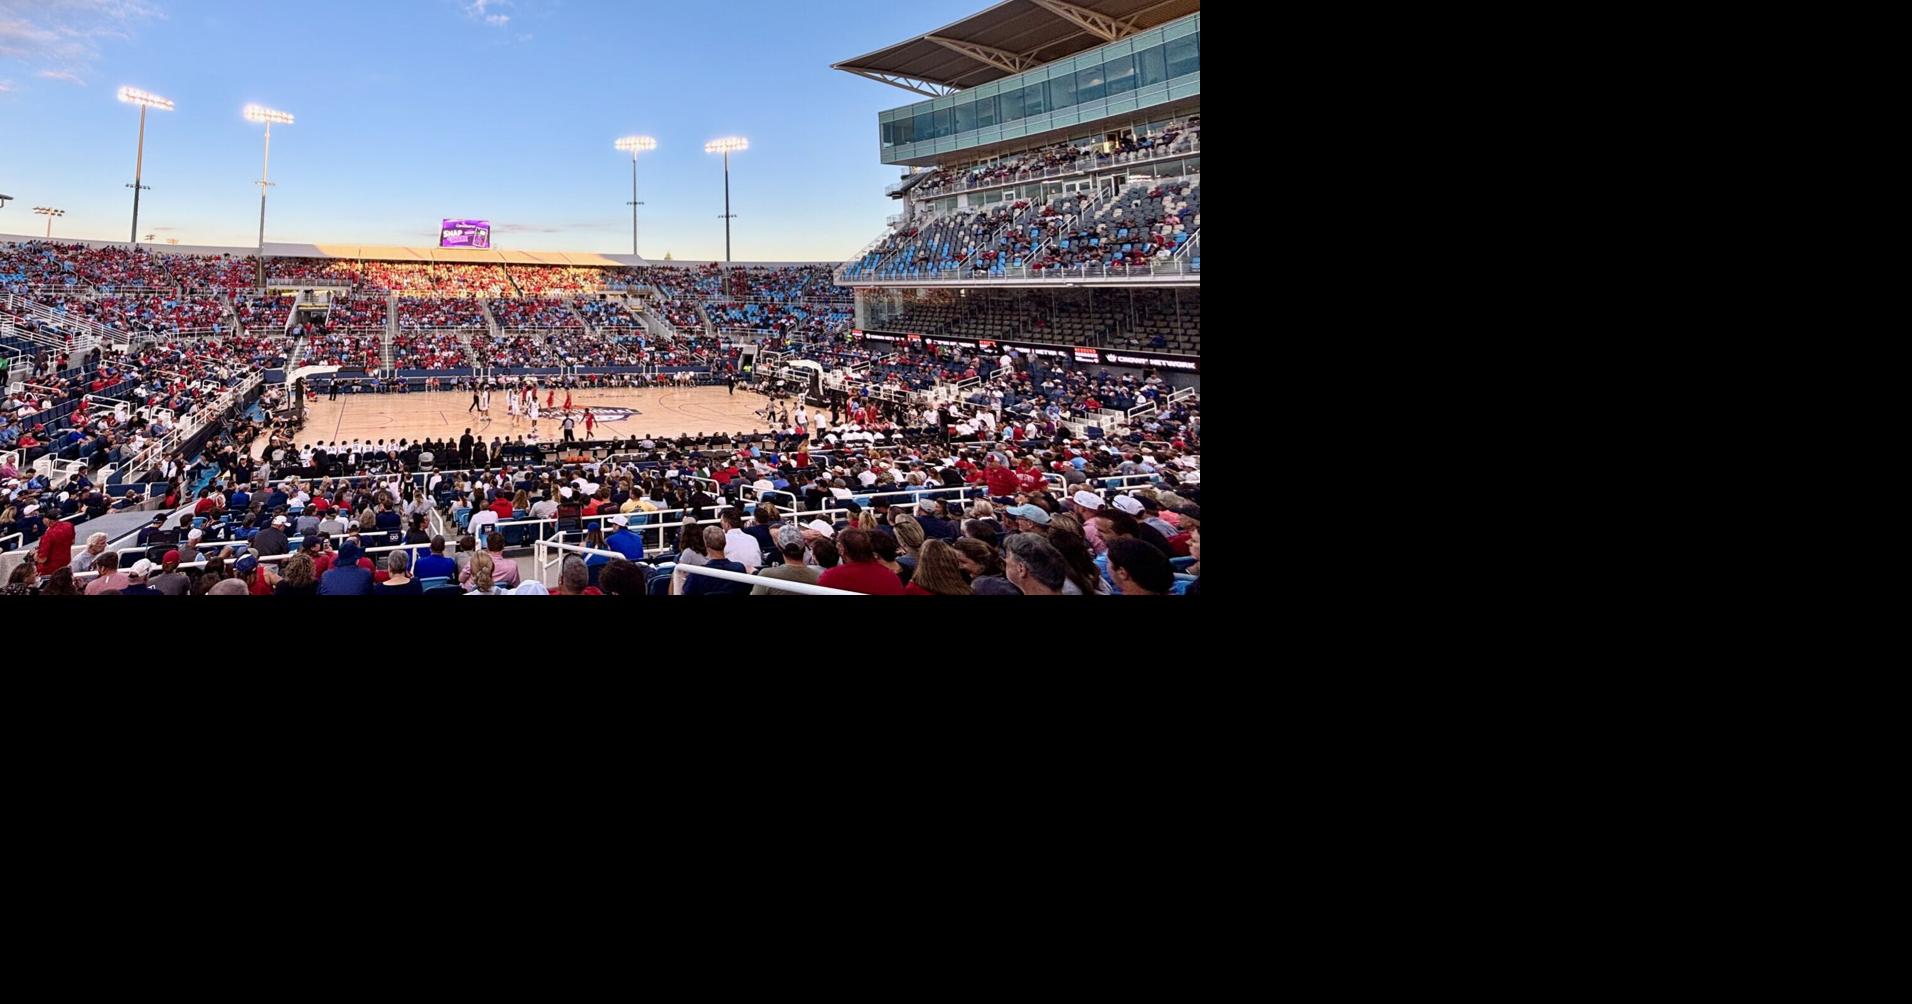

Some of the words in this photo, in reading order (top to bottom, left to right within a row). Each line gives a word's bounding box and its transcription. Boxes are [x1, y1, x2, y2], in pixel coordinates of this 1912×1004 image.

[443, 230, 463, 238] SNAP
[1150, 359, 1196, 369] NETWORK
[217, 528, 225, 539] 4
